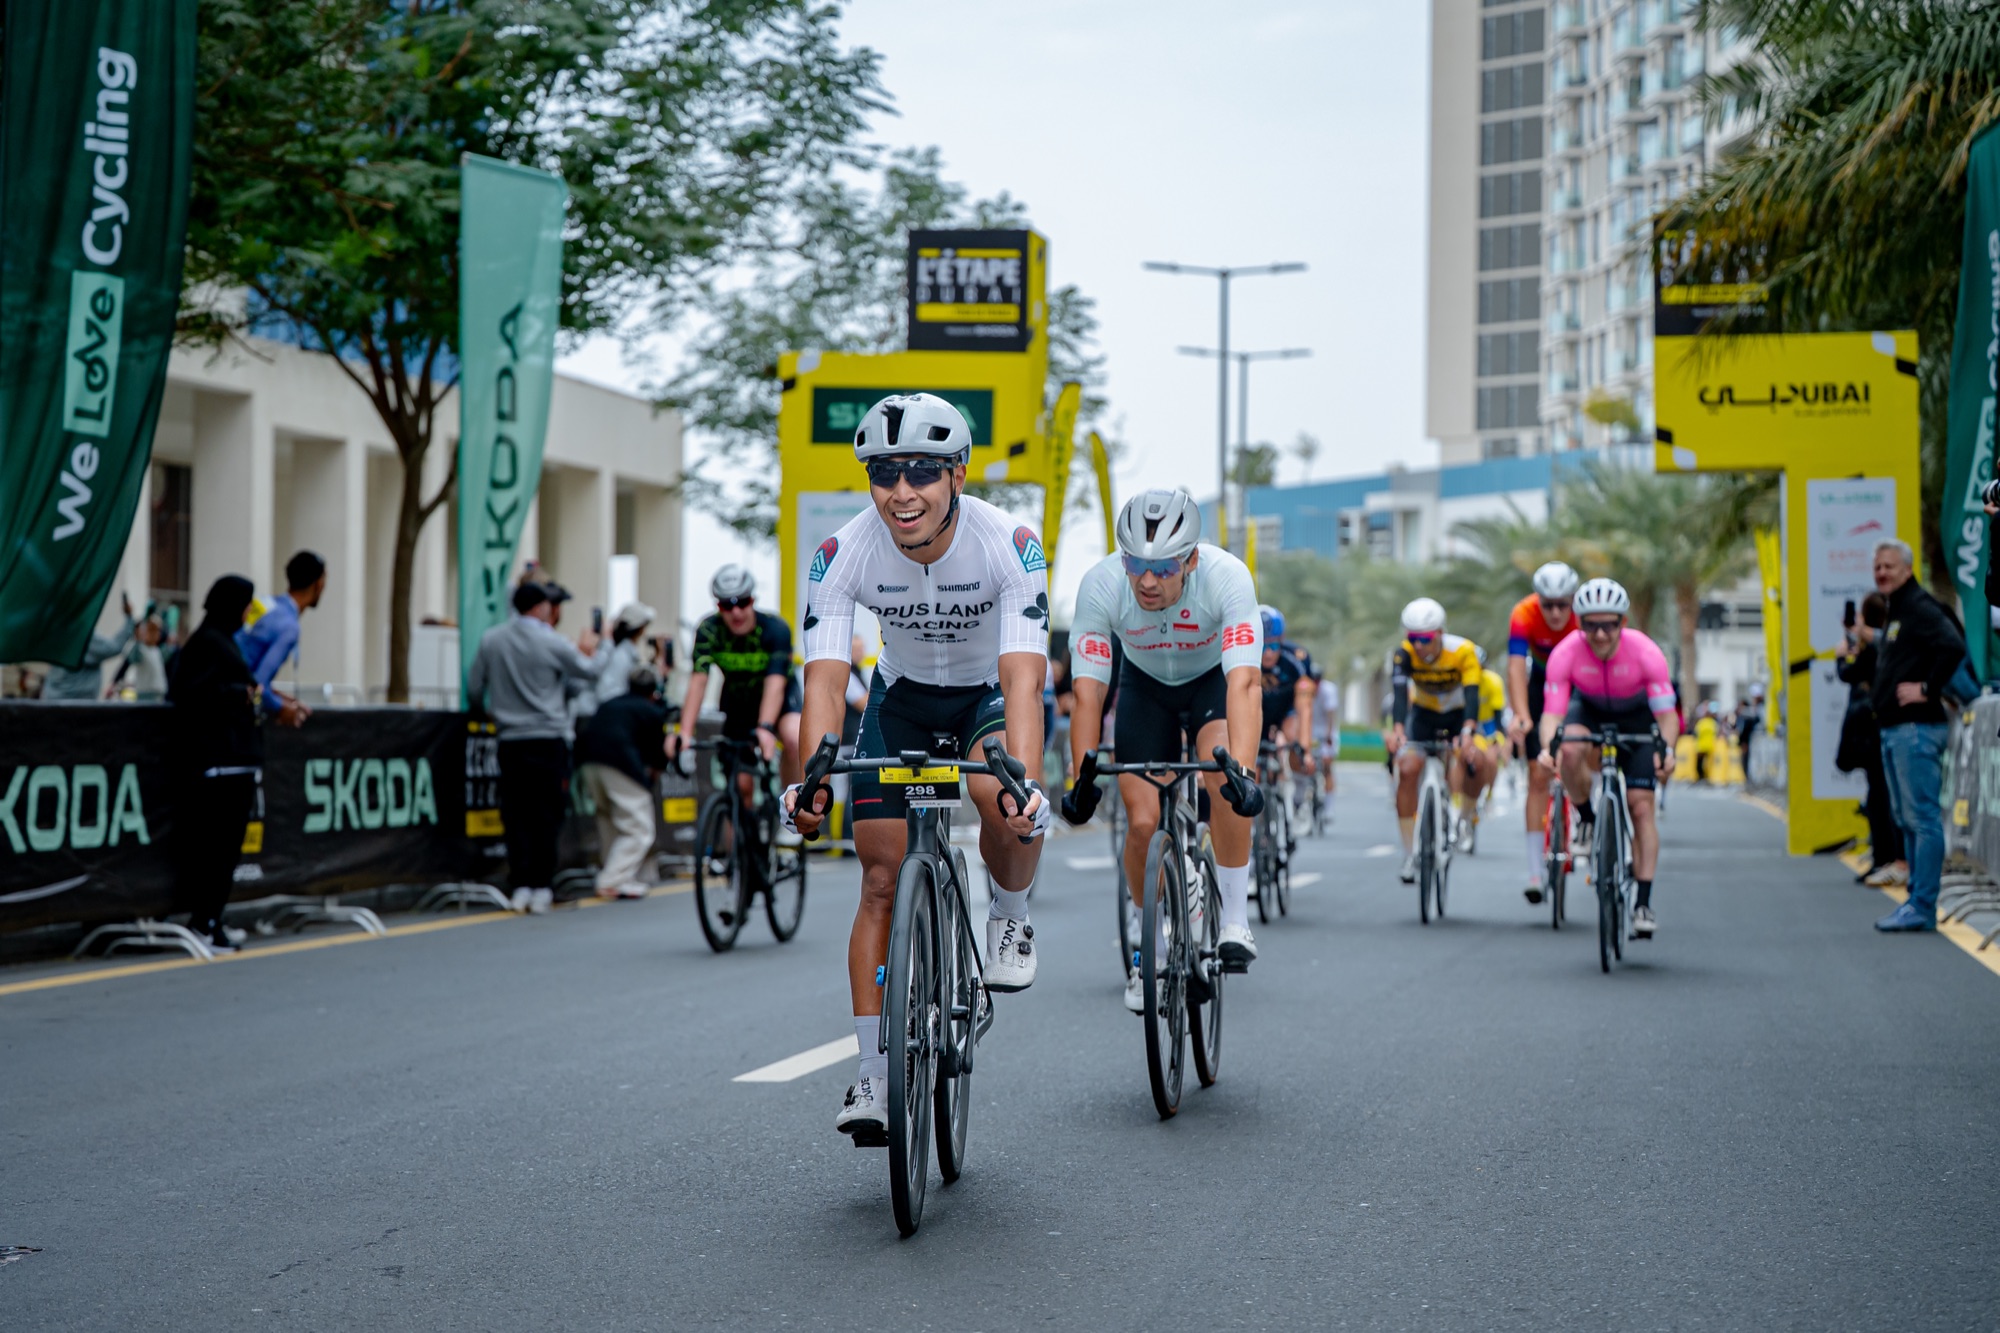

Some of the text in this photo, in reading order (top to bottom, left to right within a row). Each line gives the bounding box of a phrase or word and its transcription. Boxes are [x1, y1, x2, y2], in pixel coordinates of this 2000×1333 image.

[52, 47, 138, 542] We Love Cycling
[1957, 516, 1984, 589] We
[937, 581, 981, 592] SHIMANO
[868, 601, 994, 619] OPUS LAND
[889, 620, 981, 630] RACING
[303, 758, 439, 833] SKODA
[905, 785, 936, 795] 298
